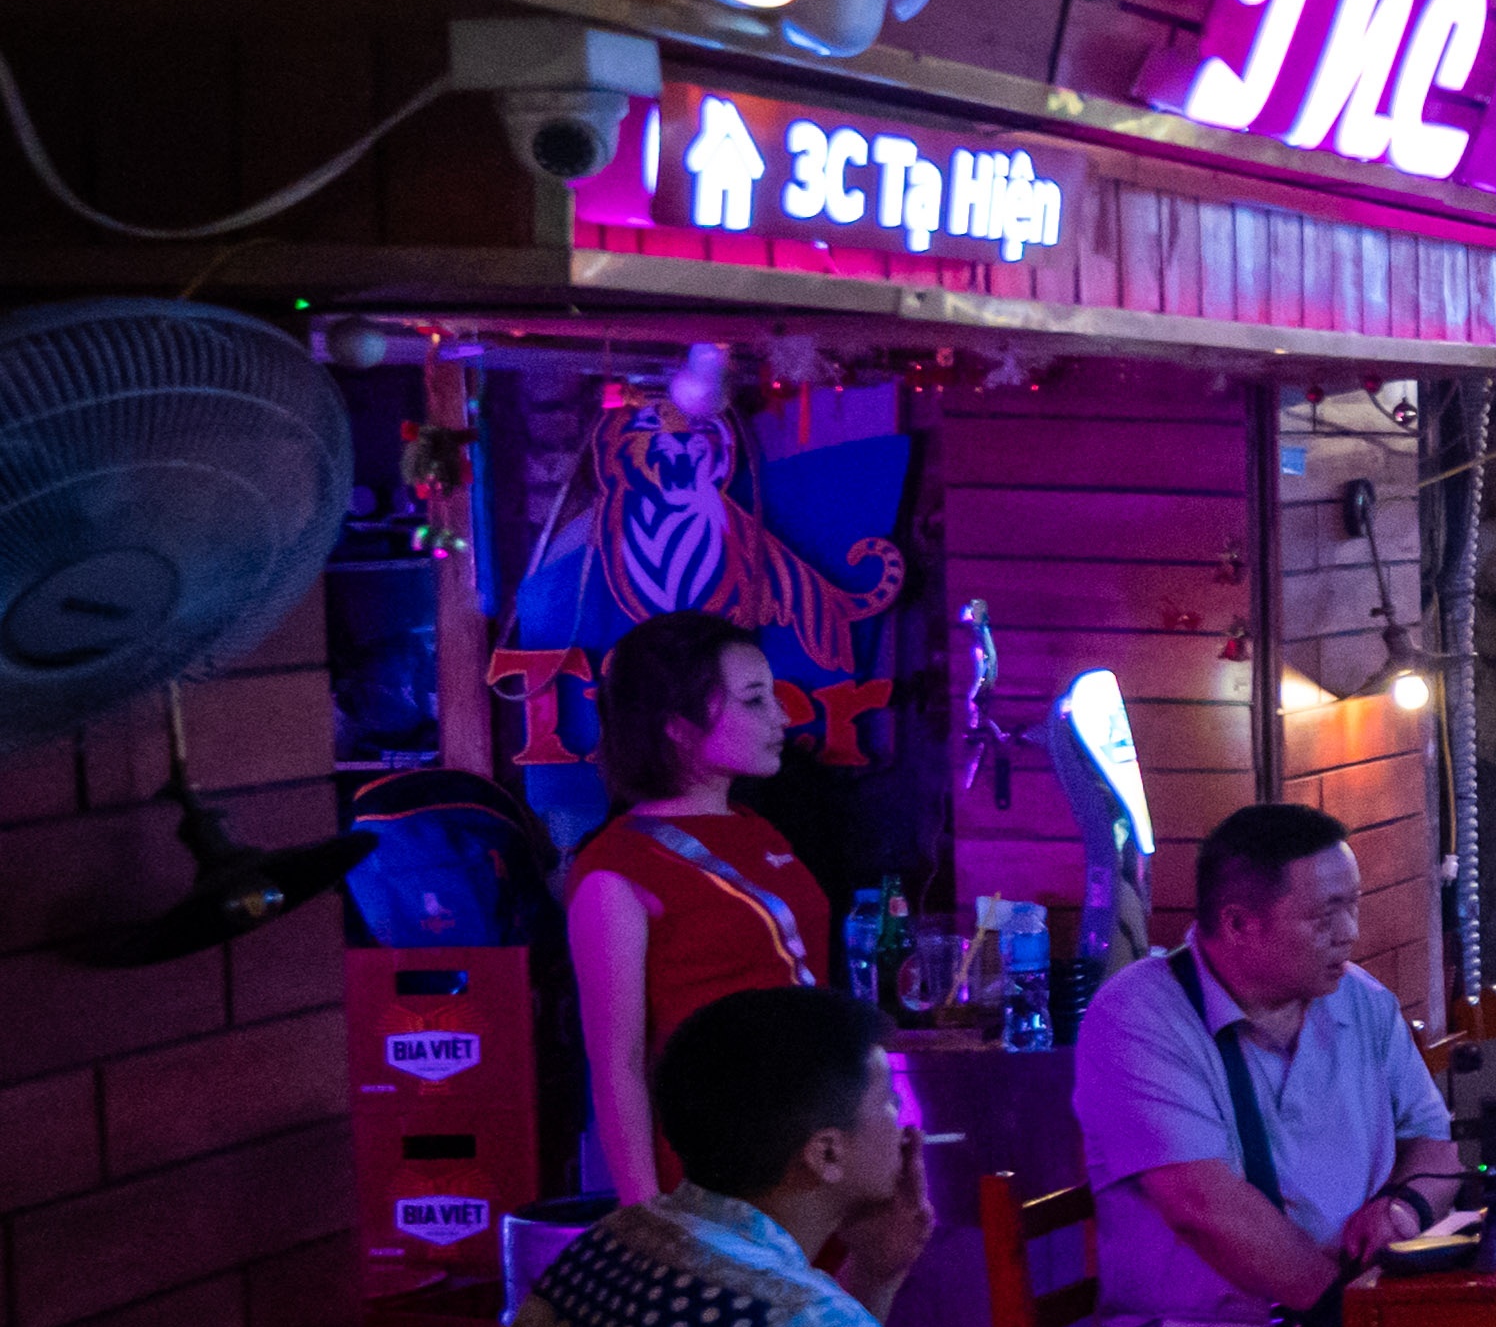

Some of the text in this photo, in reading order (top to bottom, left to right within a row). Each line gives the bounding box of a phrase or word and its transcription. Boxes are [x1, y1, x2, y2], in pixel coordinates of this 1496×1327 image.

[782, 119, 1062, 262] 3C Tạ Hiện
[393, 1039, 429, 1062] BIA
[403, 1204, 438, 1226] BIA
